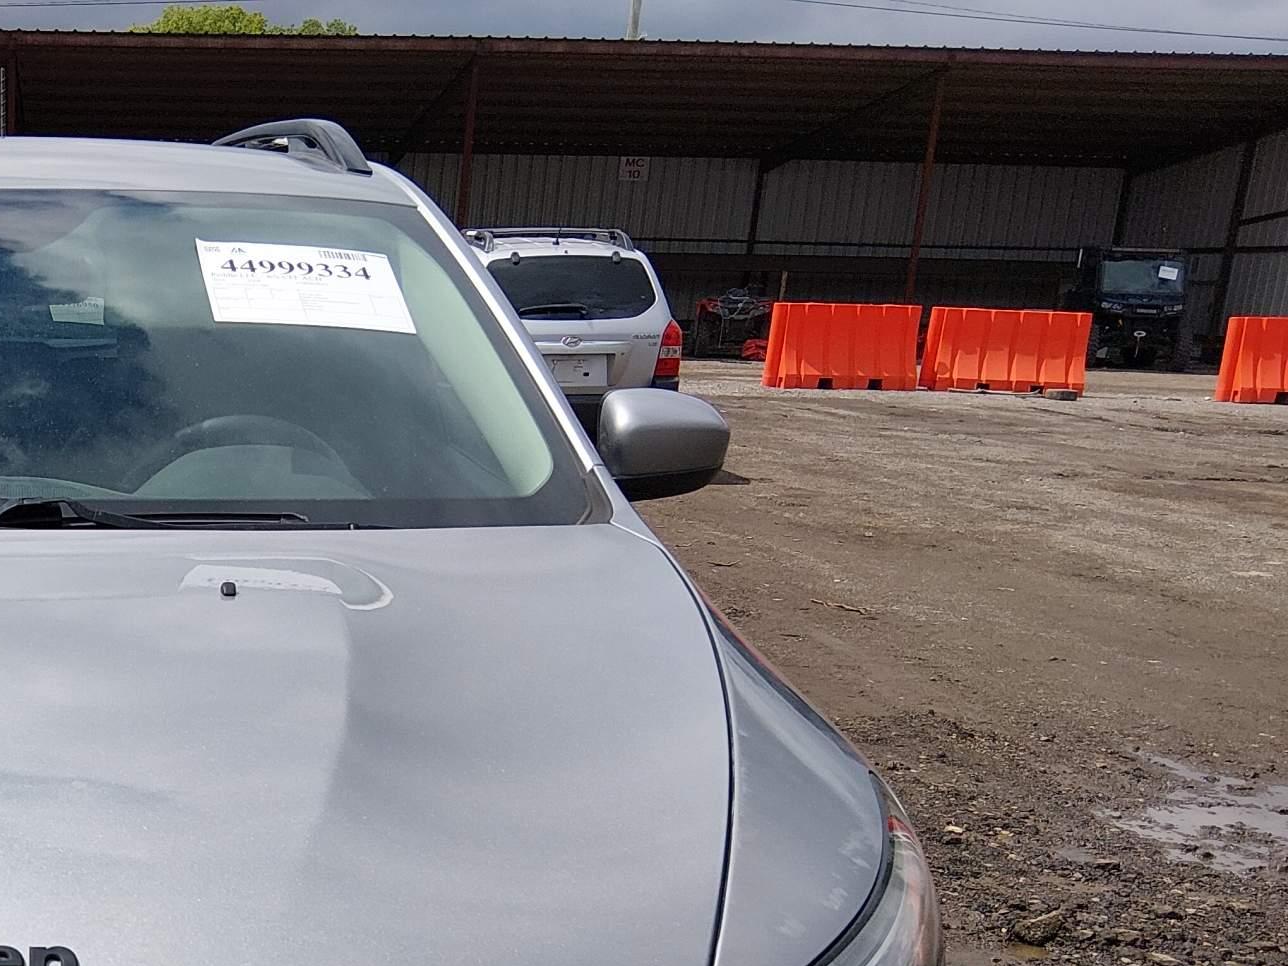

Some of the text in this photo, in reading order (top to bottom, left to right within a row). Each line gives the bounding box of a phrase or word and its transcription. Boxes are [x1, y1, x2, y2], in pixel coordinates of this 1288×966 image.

[625, 158, 644, 167] MC
[626, 170, 640, 178] 10
[220, 258, 372, 281] 44999334
